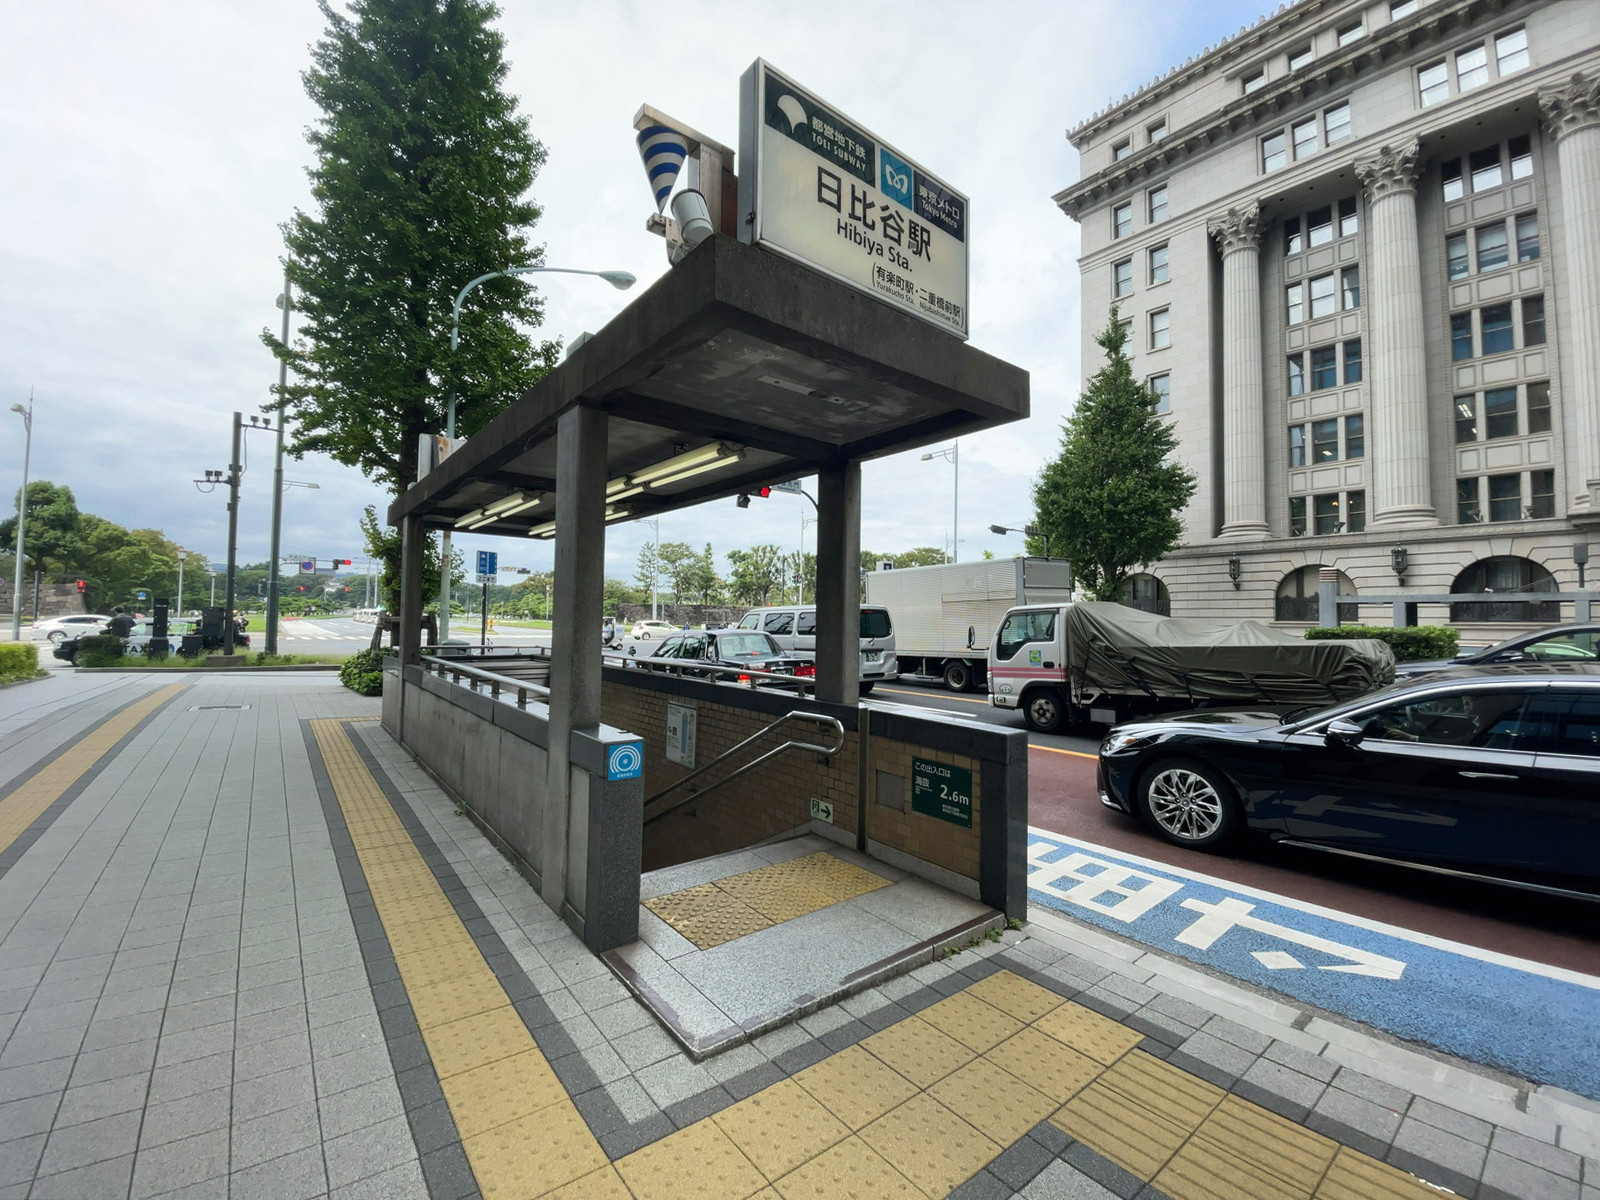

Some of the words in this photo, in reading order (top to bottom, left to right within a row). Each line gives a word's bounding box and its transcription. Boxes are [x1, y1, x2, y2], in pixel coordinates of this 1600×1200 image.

[811, 116, 866, 160] 都営地下鉄
[811, 132, 831, 151] TOEI
[833, 145, 866, 172] SUBWAY
[817, 165, 932, 263] 日比谷駅
[918, 184, 960, 220] 東京メトロ
[921, 198, 939, 218] Tokyo
[939, 211, 958, 229] Metro
[836, 219, 884, 258] Hibiya
[888, 247, 913, 273] Sta.
[876, 280, 905, 300] Yurakucho
[905, 293, 915, 305] Sta.
[124, 645, 145, 654] TAX
[914, 762, 952, 778] この出入口は
[915, 775, 930, 788] 海抜
[939, 784, 969, 806] 2.6m
